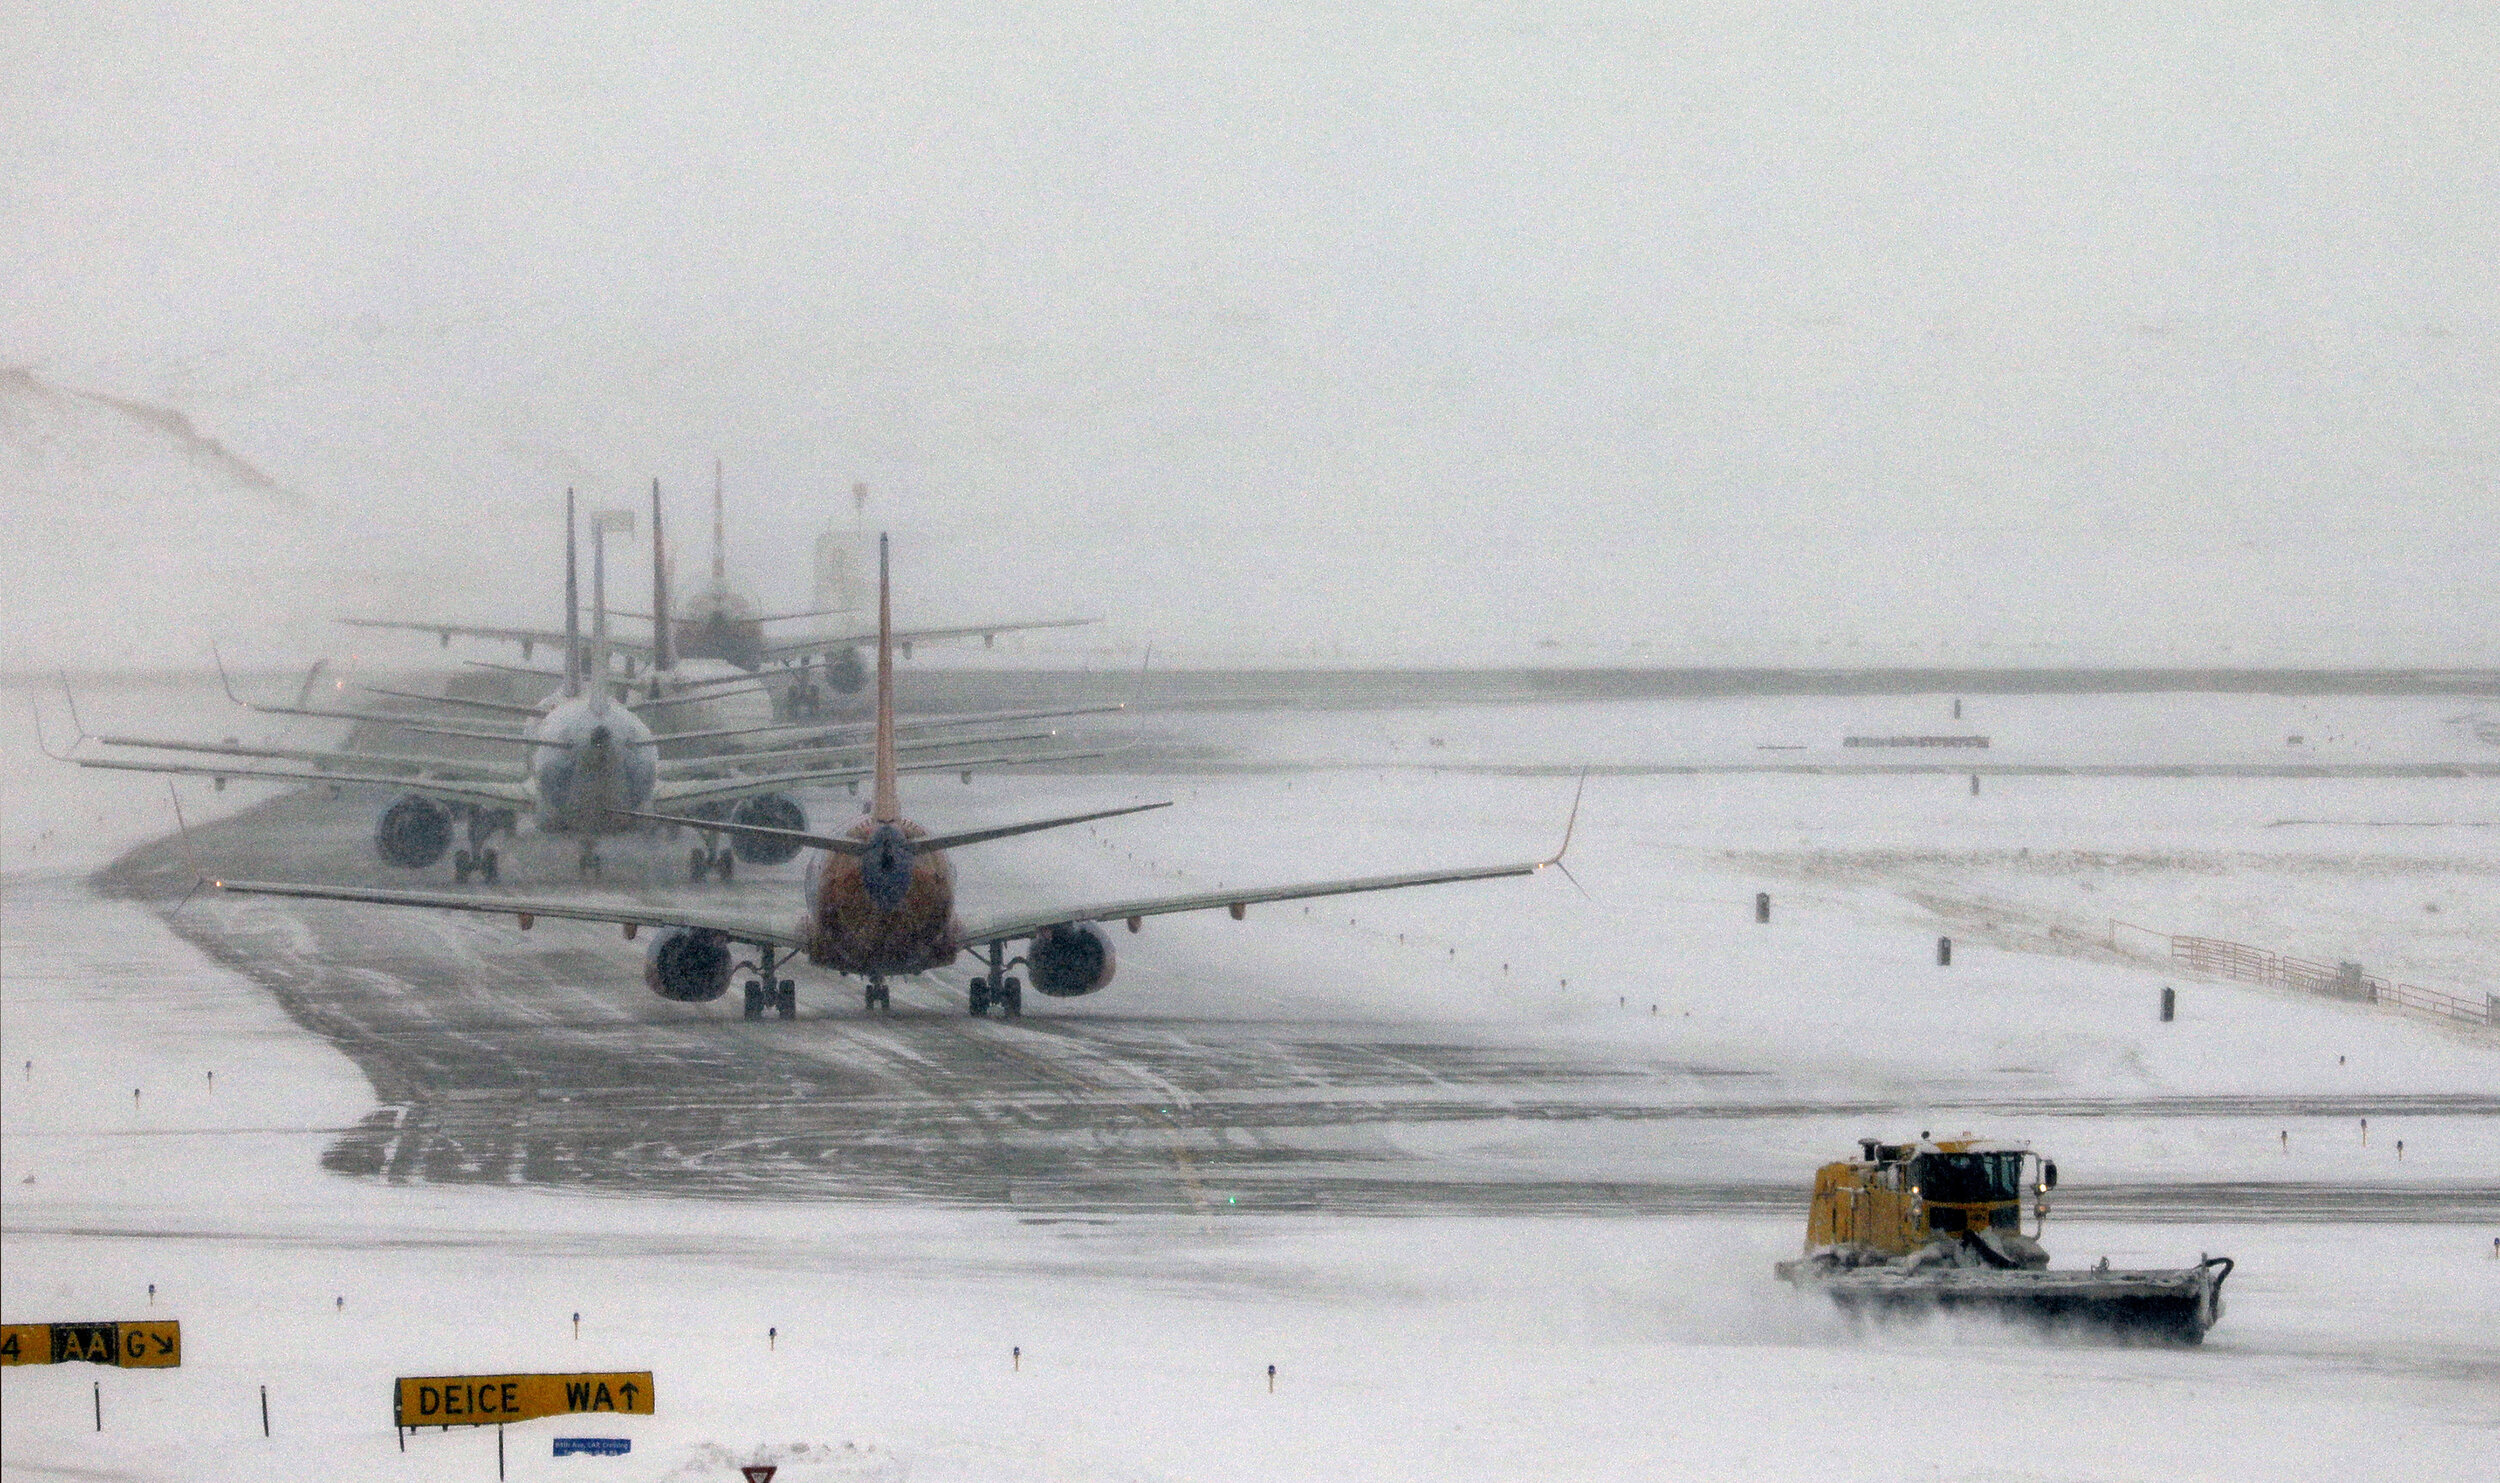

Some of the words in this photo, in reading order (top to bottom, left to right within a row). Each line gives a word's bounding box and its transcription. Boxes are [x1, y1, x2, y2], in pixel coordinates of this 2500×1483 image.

[1, 1333, 21, 1361] 4
[63, 1331, 108, 1359] AA
[127, 1330, 145, 1358] G
[420, 1383, 520, 1416] DEICE
[565, 1382, 614, 1412] WA
